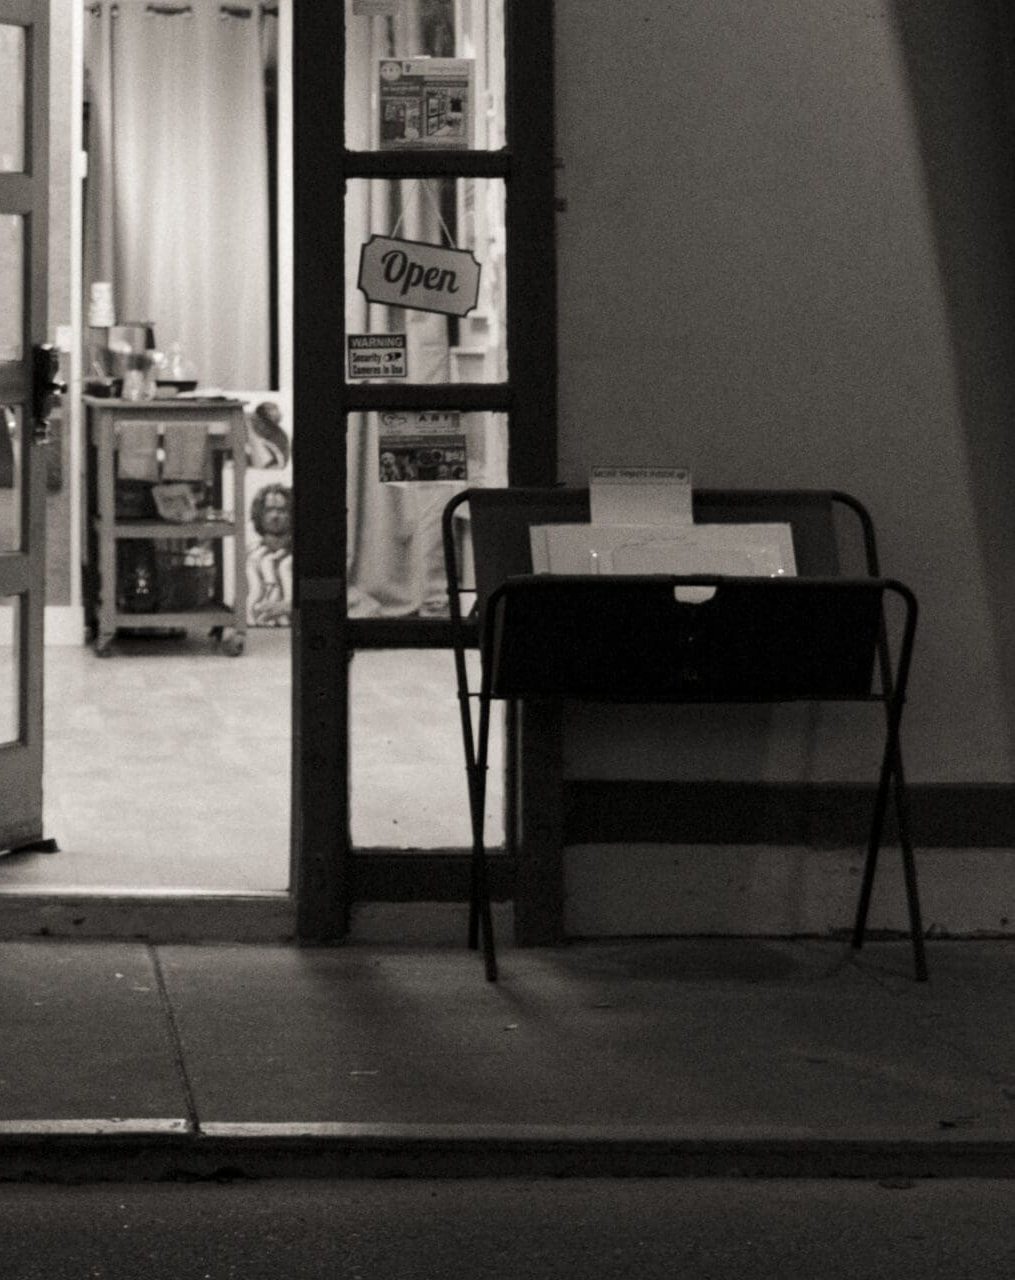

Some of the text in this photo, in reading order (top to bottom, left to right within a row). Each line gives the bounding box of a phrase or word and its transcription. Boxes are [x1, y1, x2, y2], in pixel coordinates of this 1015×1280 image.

[381, 250, 459, 296] Open
[352, 337, 403, 348] WARNING
[353, 352, 381, 365] Security
